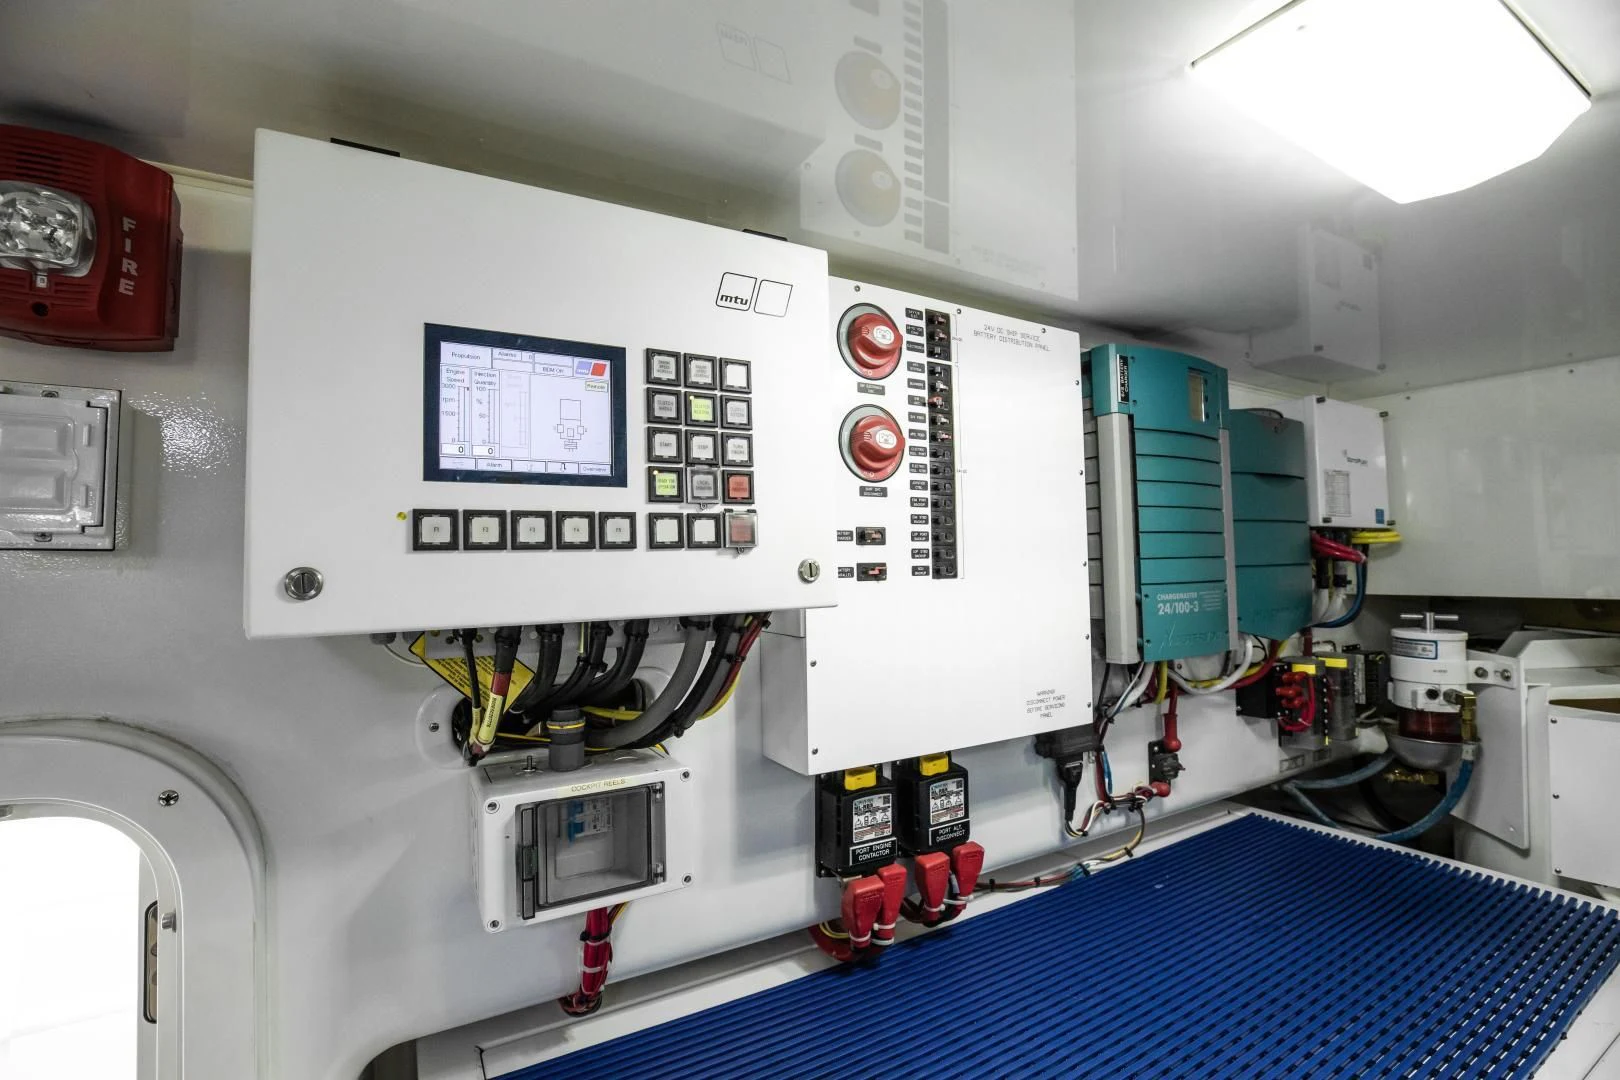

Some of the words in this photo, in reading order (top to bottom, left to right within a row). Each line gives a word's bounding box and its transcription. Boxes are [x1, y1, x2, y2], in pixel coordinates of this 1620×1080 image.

[118, 216, 138, 296] FIRE
[719, 294, 749, 306] mtu
[973, 329, 997, 340] BATTERY
[999, 335, 1033, 348] DISTRIBUTION
[451, 351, 481, 360] Propulsion
[446, 368, 465, 376] Engine
[458, 445, 464, 454] 0
[487, 447, 494, 455] 0
[1157, 601, 1199, 615] 24/100-3
[571, 781, 602, 793] COCKPIT
[603, 778, 626, 788] REELS
[936, 829, 966, 843] DISCONNECT
[938, 827, 951, 835] PORT
[855, 846, 870, 855] PORT
[872, 841, 892, 852] ENGINE
[858, 848, 890, 862] CONTACTOR
